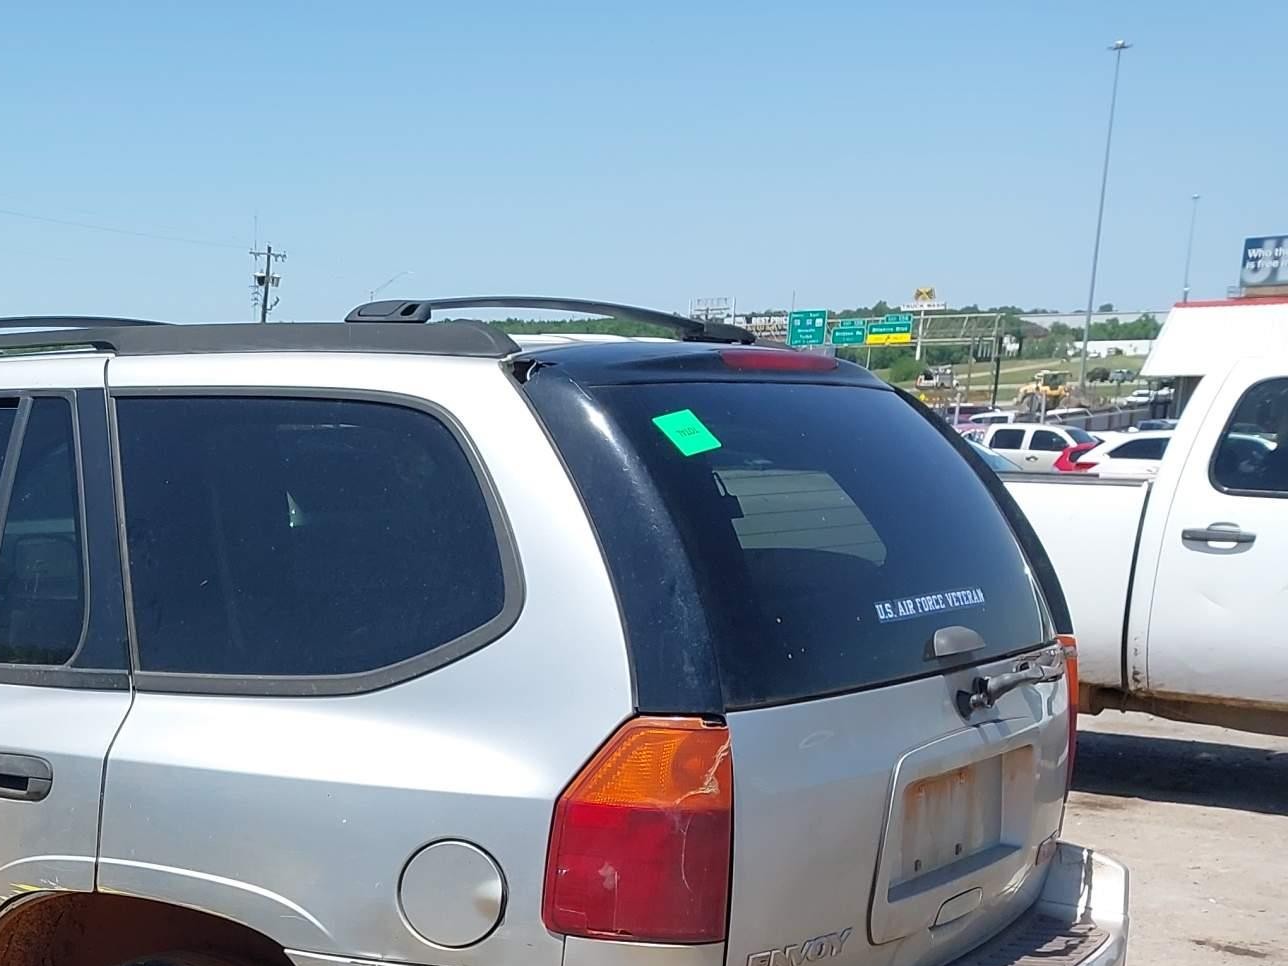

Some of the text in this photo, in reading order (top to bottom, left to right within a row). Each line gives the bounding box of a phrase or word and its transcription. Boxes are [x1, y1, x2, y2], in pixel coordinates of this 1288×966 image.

[875, 588, 985, 620] U.S. AIR FORCE VETERAN
